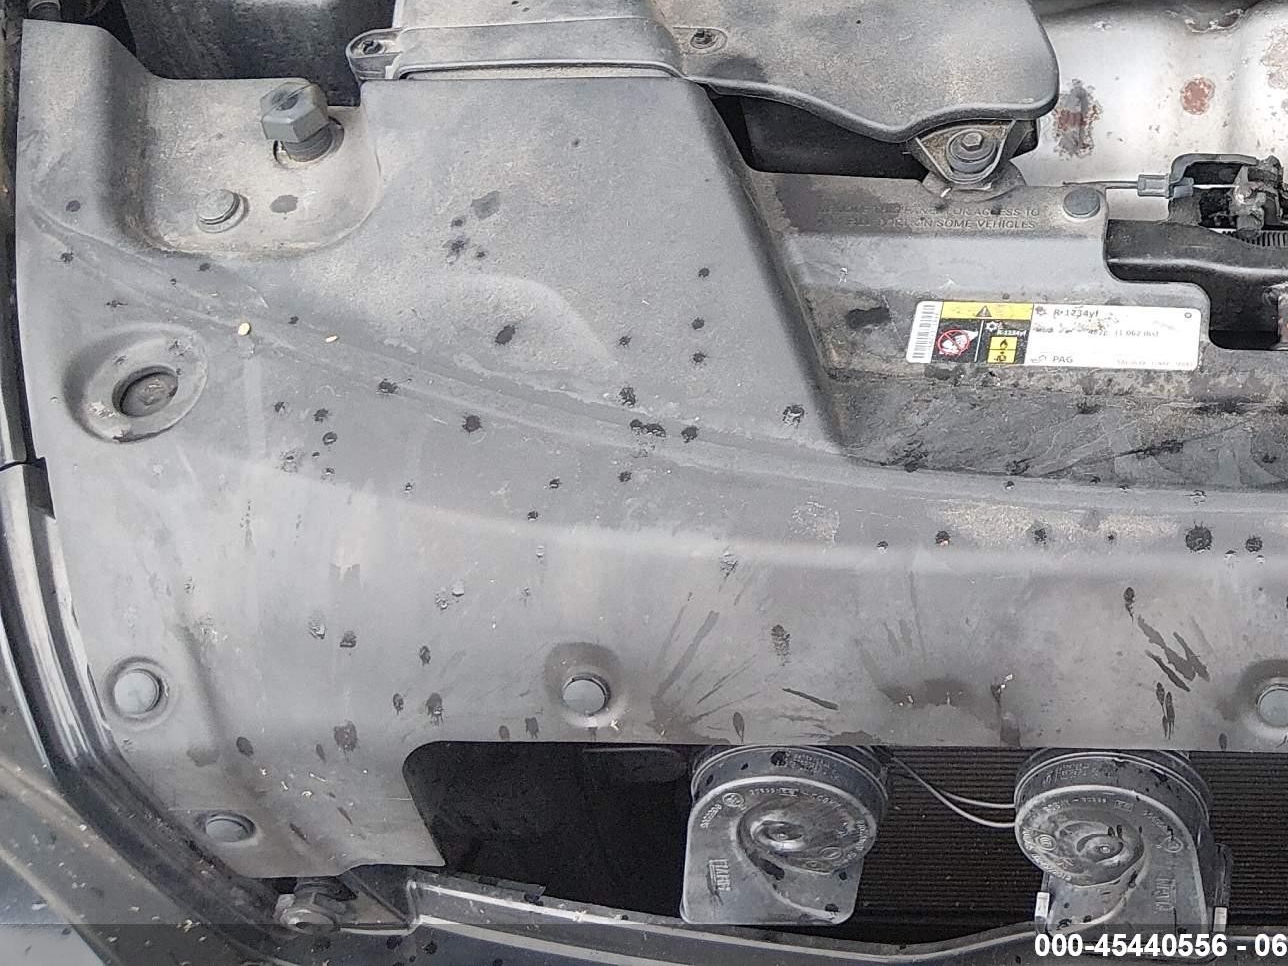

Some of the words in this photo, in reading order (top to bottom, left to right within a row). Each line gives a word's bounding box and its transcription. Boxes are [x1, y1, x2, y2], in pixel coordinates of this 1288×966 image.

[936, 219, 973, 229] SOME
[976, 219, 1036, 230] VEHICLES
[1052, 354, 1074, 364] PAG
